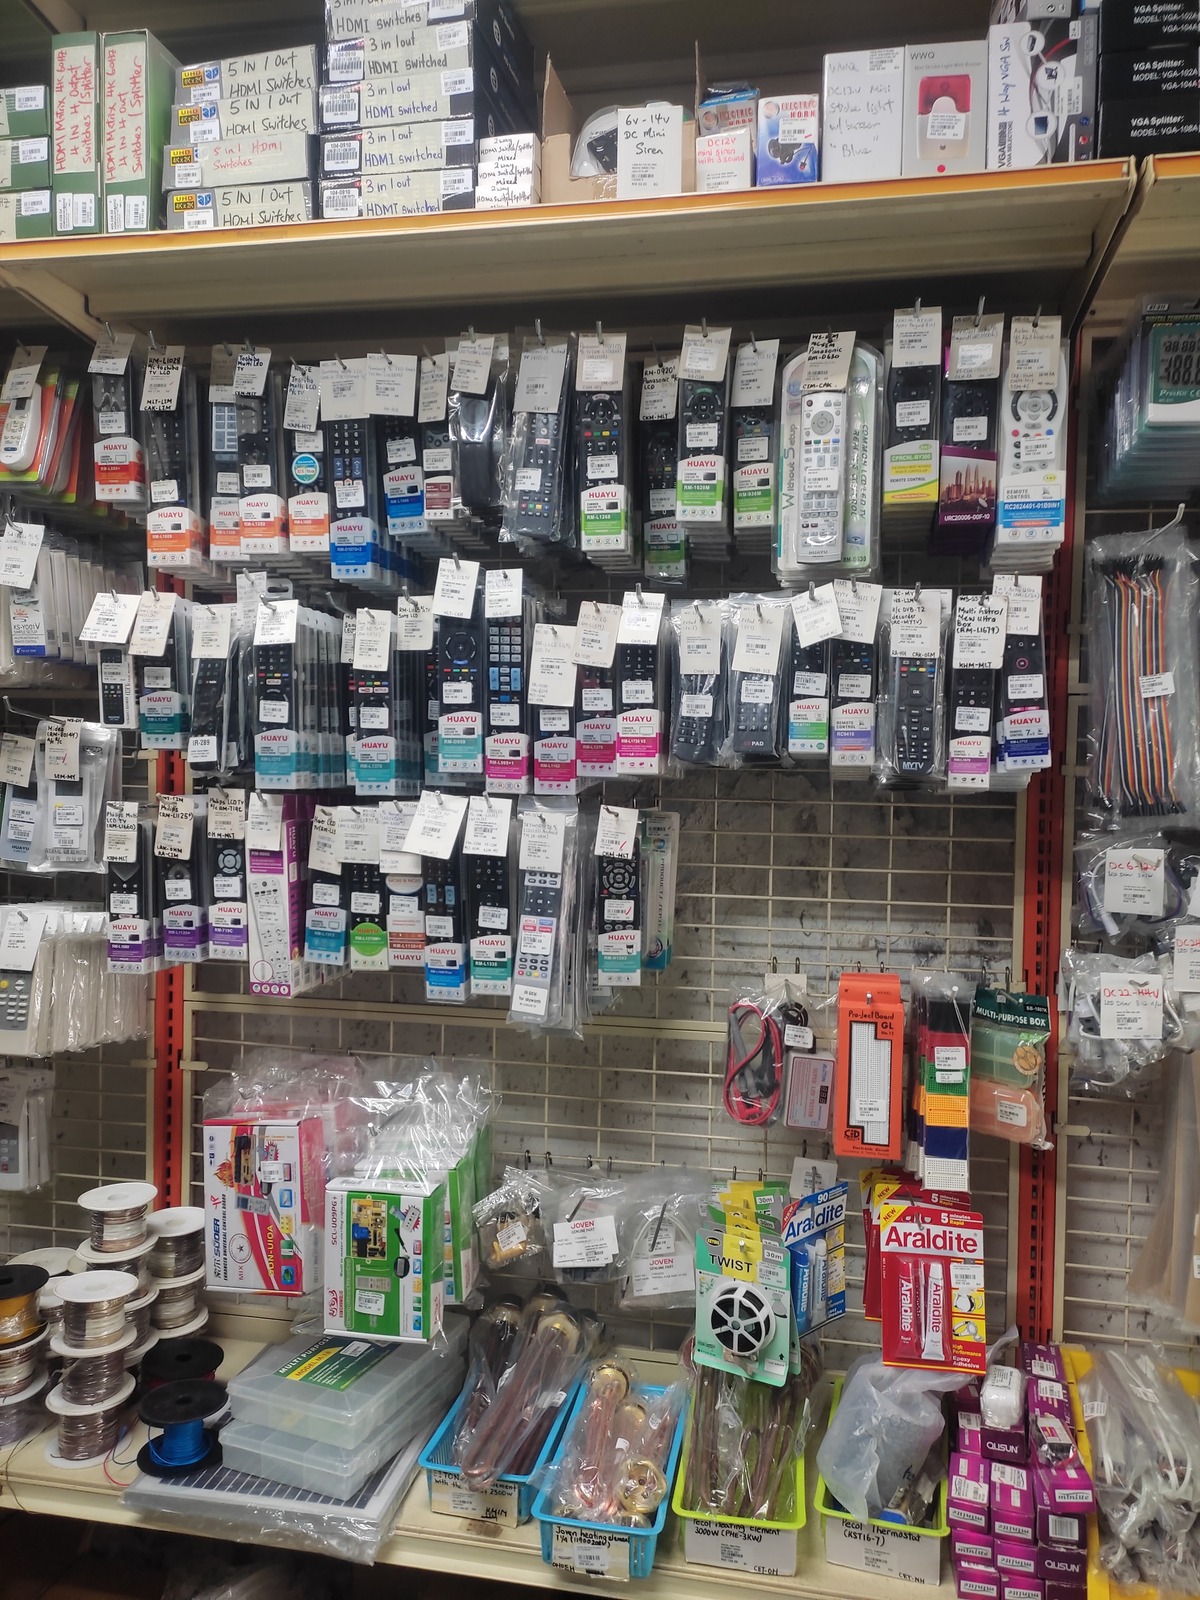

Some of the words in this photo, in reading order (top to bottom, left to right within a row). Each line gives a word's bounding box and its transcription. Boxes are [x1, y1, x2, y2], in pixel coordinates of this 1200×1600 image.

[1134, 5, 1151, 14] VGA
[335, 17, 371, 34] HDMI
[376, 10, 422, 30] switches
[369, 38, 378, 52] 3
[228, 62, 238, 77] 5
[244, 60, 256, 74] IN
[275, 51, 298, 69] Out
[368, 60, 399, 75] HDMI
[405, 53, 448, 71] switched
[1133, 61, 1150, 71] VGA
[230, 80, 262, 99] HDMI
[366, 82, 376, 98] 3
[230, 100, 240, 115] 5
[246, 98, 260, 111] IN
[279, 92, 302, 106] Out
[781, 101, 817, 111] ELECTRIC
[365, 106, 396, 120] HDMI
[398, 101, 439, 116] switched
[790, 110, 816, 119] HORN
[226, 121, 256, 138] HDMI
[262, 115, 308, 132] Switches
[1131, 118, 1149, 128] VGA
[366, 130, 375, 145] 3
[624, 130, 638, 140] DC
[635, 141, 664, 156] Siren
[364, 153, 395, 167] HDMI
[399, 146, 443, 163] switched
[366, 179, 374, 194] 3
[222, 191, 232, 207] 5
[237, 190, 252, 205] IN
[270, 186, 294, 205] Out
[740, 467, 769, 476] HUAYU
[389, 474, 415, 482] HUAYU
[446, 716, 477, 724] HUAYU
[1009, 717, 1041, 725] HUAYU
[218, 906, 243, 914] HUAYU
[478, 939, 507, 947] HUAYU
[429, 947, 457, 956] HUAYU
[880, 1021, 894, 1030] GL
[1029, 1016, 1046, 1027] BOX
[877, 1185, 890, 1198] NEW
[817, 1192, 828, 1204] 90
[931, 1193, 939, 1203] 5
[883, 1207, 896, 1222] NEW
[941, 1212, 949, 1224] 5
[570, 1220, 595, 1230] JOVEN
[884, 1225, 978, 1254] Araldite
[649, 1258, 674, 1266] JOVEN
[766, 1252, 782, 1260] 30m
[708, 1253, 753, 1274] TWIST
[901, 1279, 913, 1333] Araldite
[931, 1282, 942, 1334] Araldite
